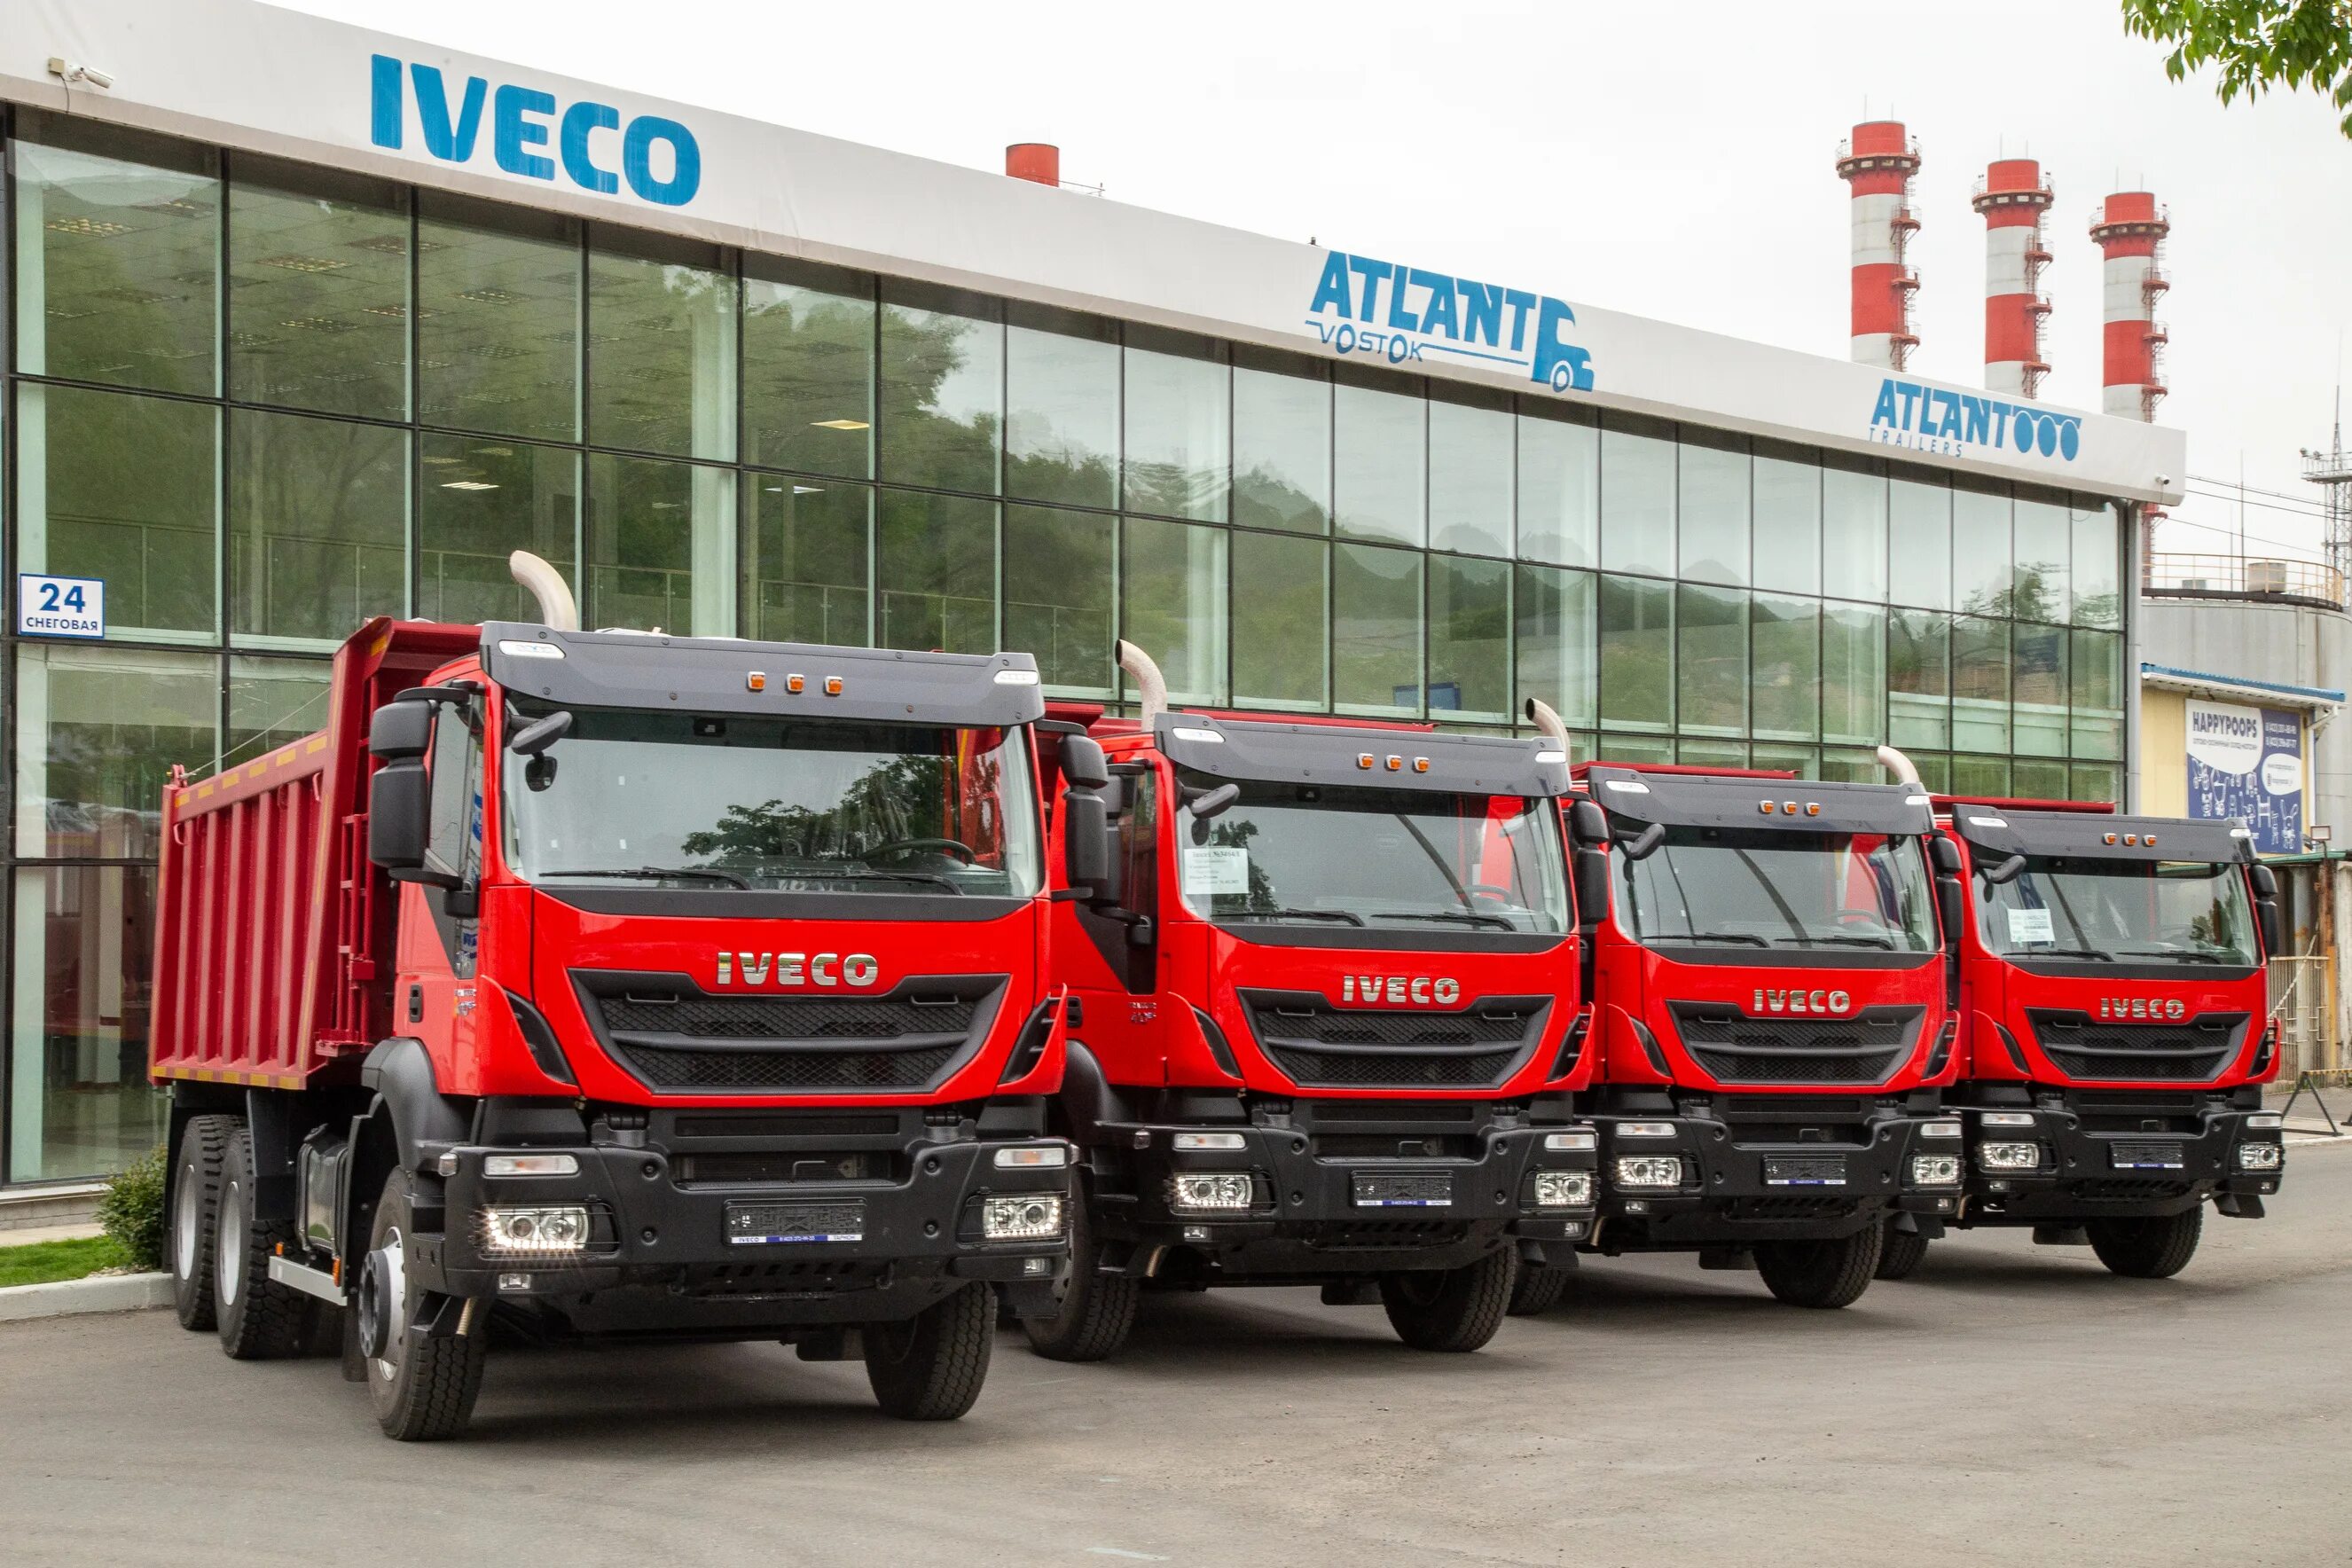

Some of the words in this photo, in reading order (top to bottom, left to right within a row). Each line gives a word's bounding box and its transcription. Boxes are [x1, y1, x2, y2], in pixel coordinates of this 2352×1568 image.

[372, 54, 701, 206] IVECO
[1310, 249, 1537, 352] ATLANT
[1317, 320, 1423, 365] VOSTOK
[1870, 378, 2012, 449] ATLANT
[1869, 427, 1963, 458] TRAILERS
[39, 583, 86, 613] 24
[26, 616, 98, 631] СНЕГОВАЯ
[2192, 711, 2257, 738] HAPPYPOOPS
[717, 952, 878, 986] IVECO
[1343, 976, 1461, 1004] IVECO
[1753, 989, 1851, 1013] IVECO
[2100, 998, 2185, 1020] IVECO
